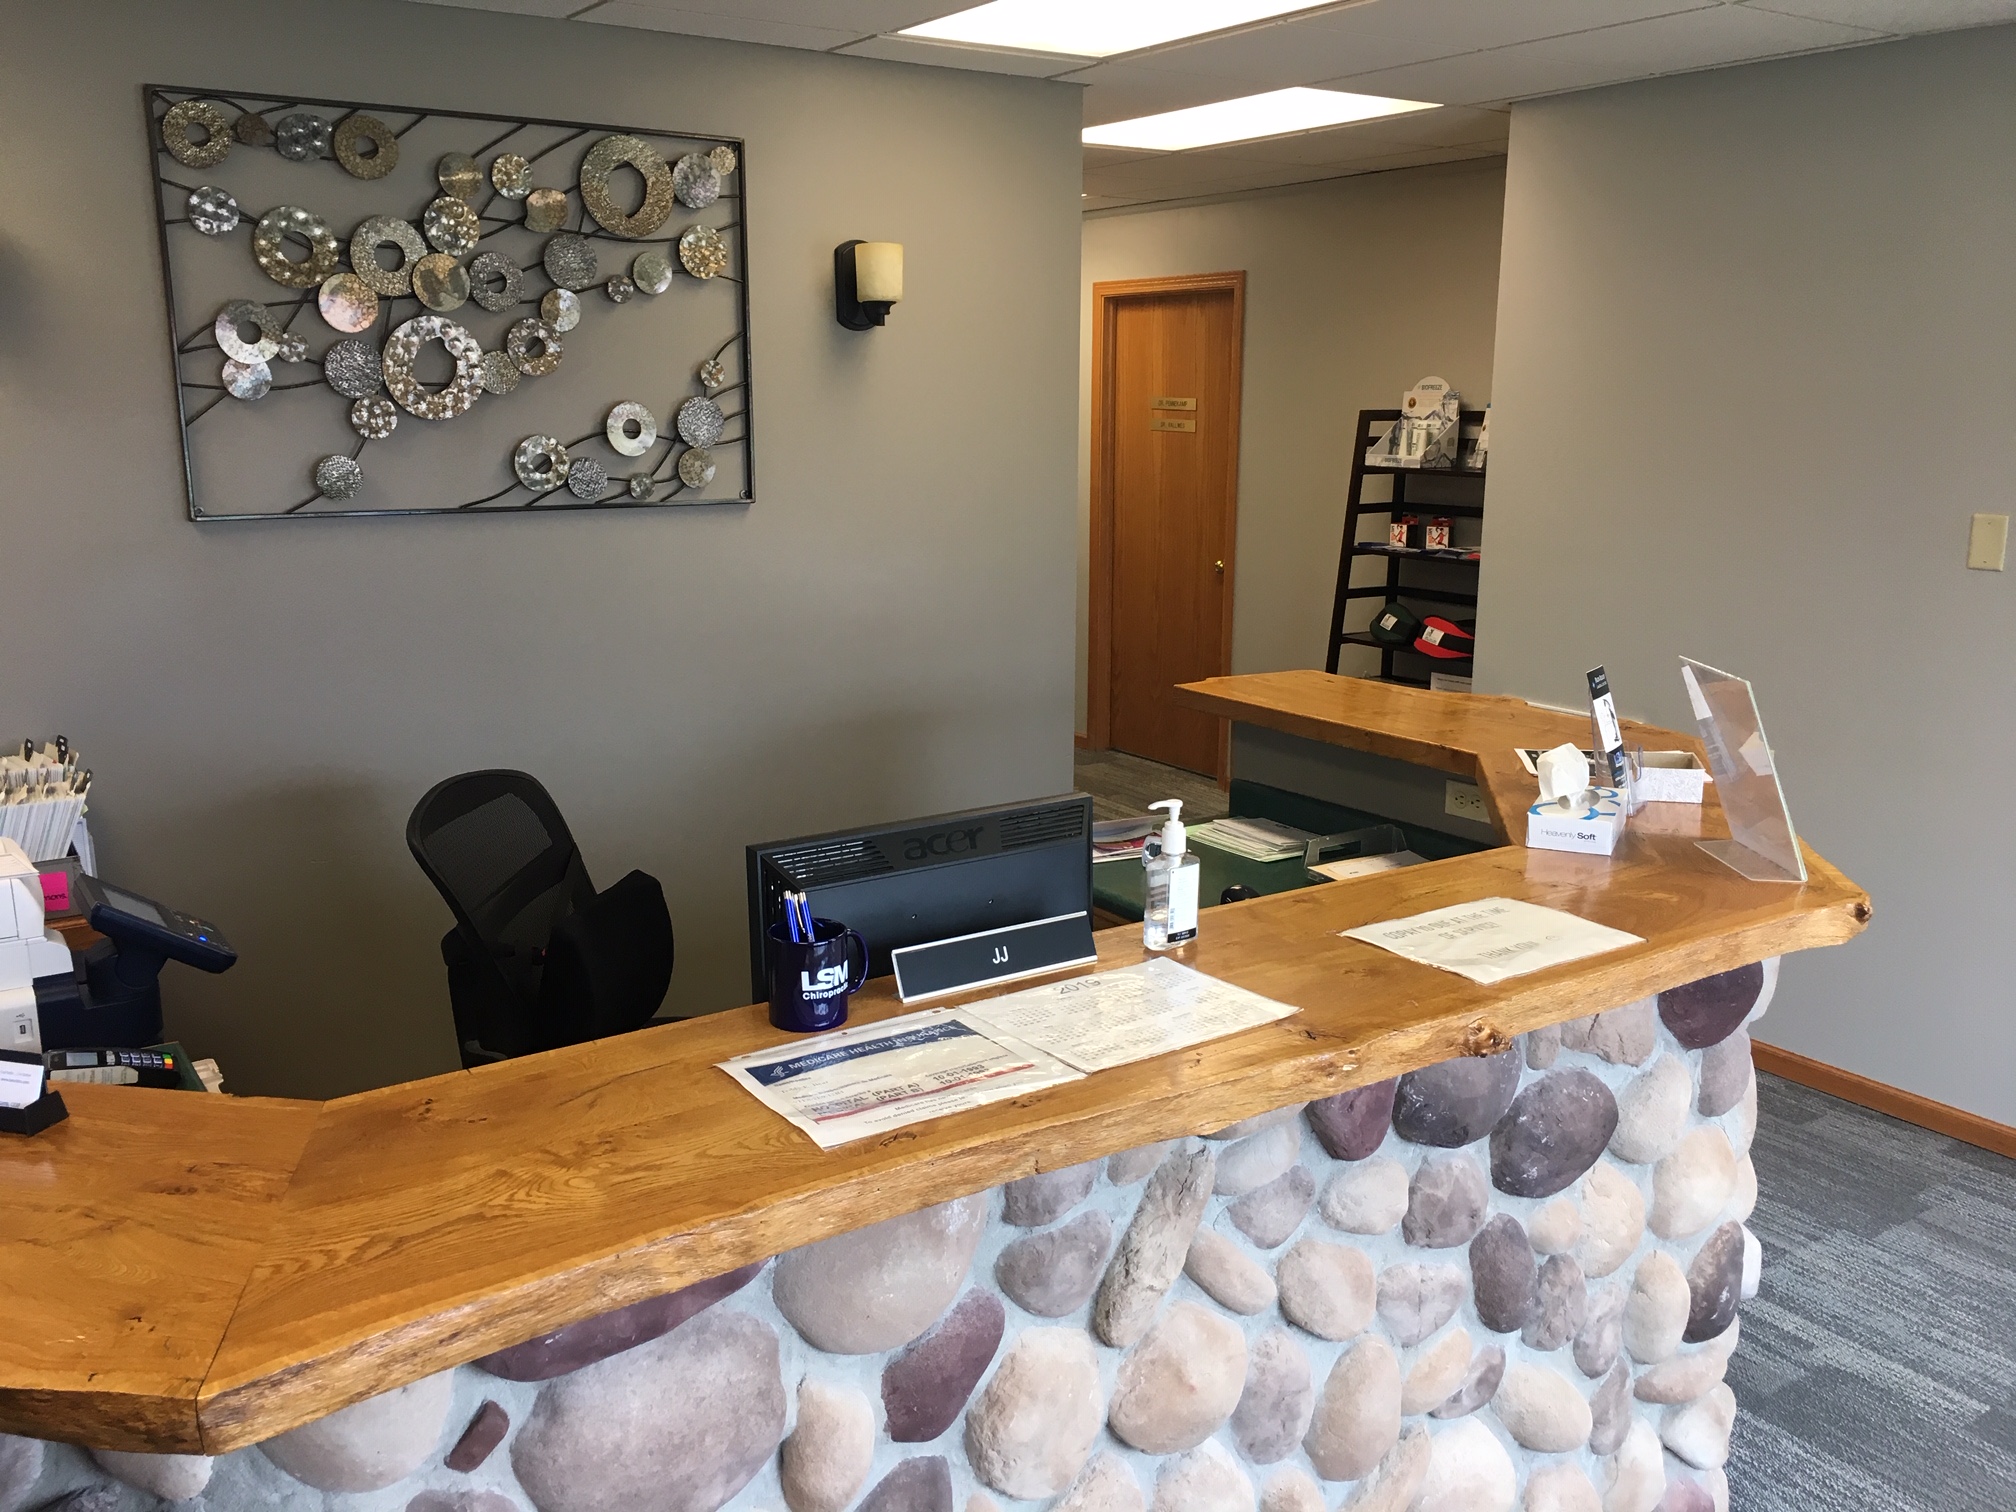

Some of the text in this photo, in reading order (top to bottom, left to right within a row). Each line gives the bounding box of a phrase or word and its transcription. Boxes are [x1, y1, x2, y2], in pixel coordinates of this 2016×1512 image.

[903, 825, 984, 860] acer
[1540, 828, 1597, 841] Heavenly Soft
[992, 945, 1009, 964] JJ
[801, 959, 848, 991] LSM
[1060, 979, 1101, 994] 2019
[788, 1051, 848, 1069] MEDICARE
[849, 1040, 895, 1055] HEALTH
